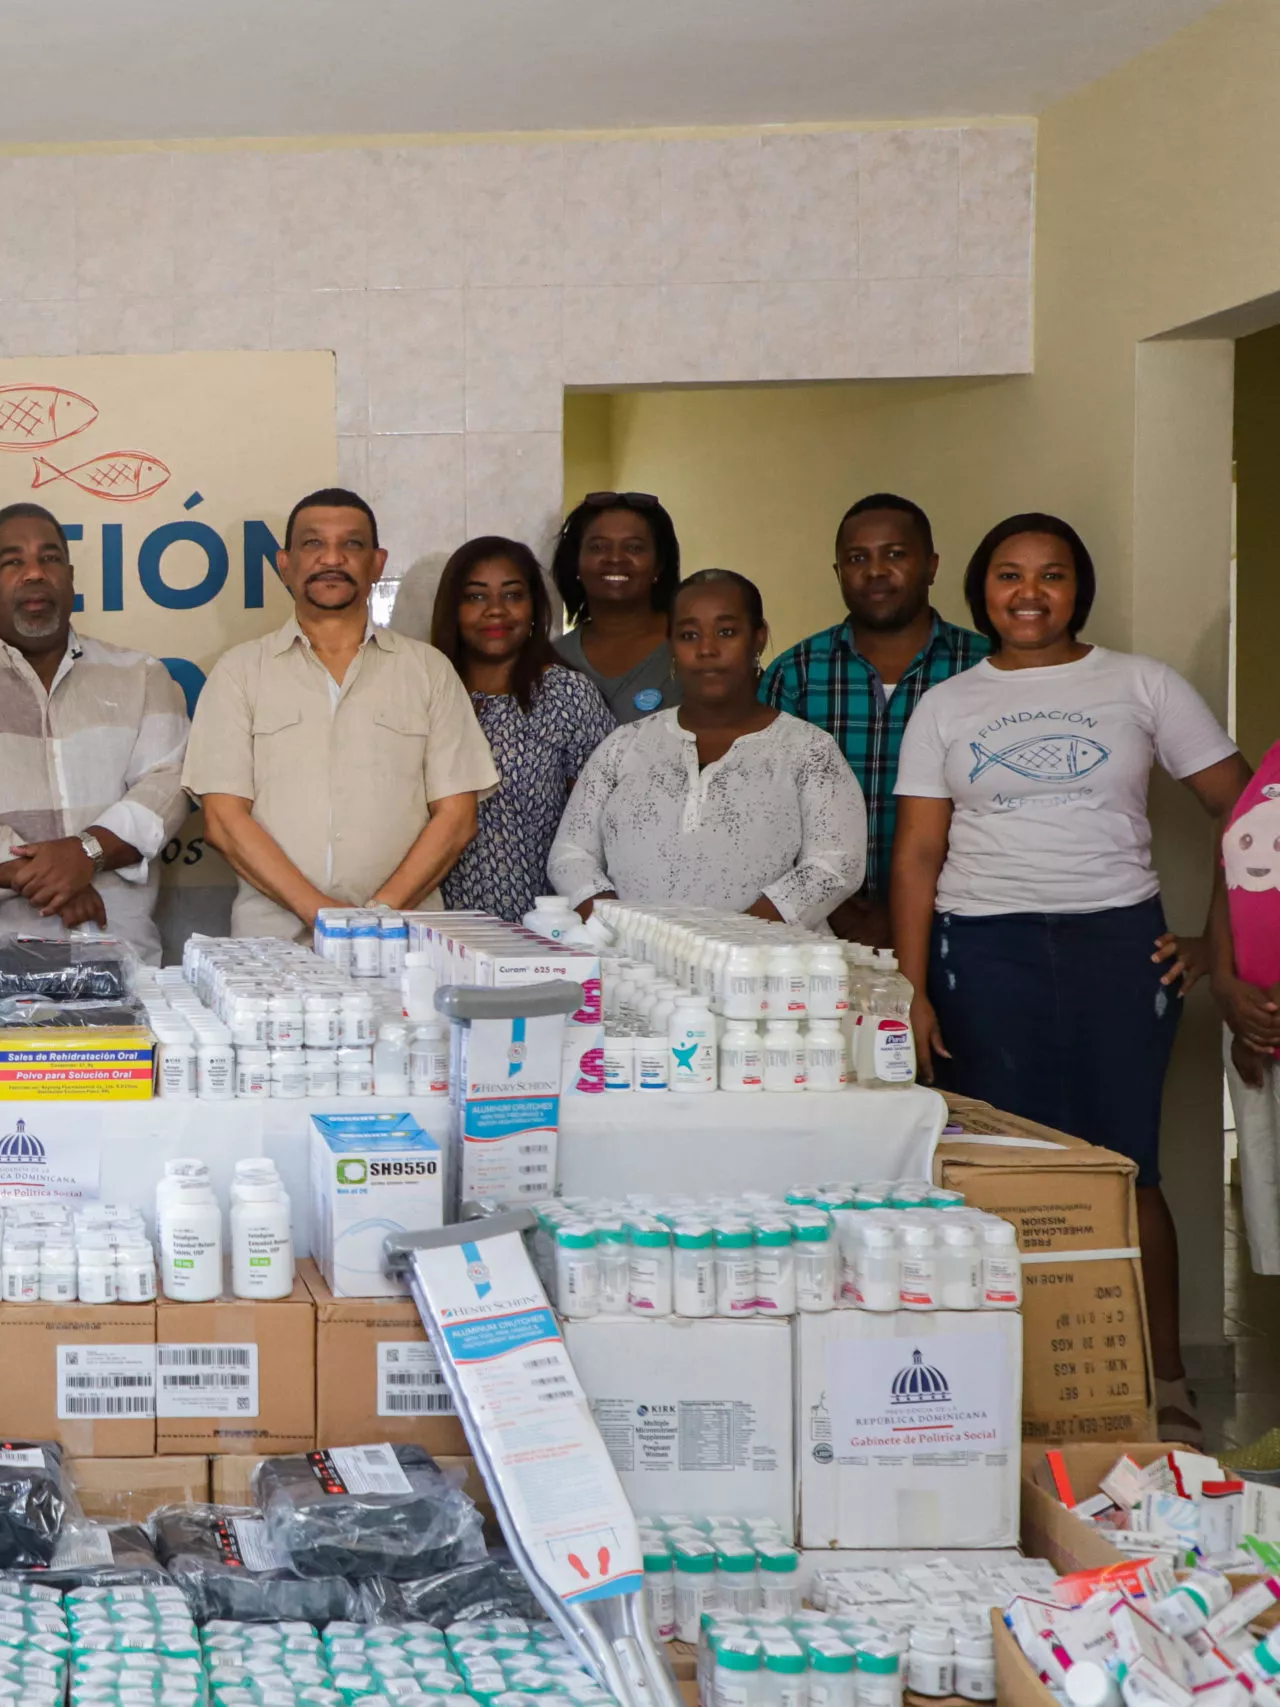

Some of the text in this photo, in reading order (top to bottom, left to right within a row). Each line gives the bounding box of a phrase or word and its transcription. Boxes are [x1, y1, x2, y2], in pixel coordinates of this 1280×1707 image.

[534, 966, 550, 974] 625
[553, 966, 567, 975] mg
[8, 1051, 139, 1062] Sales de Rehidratación Oral
[16, 1070, 133, 1081] Polvo para Solución Oral
[369, 1161, 437, 1176] SH9550
[15, 1173, 77, 1184] DOMINICANA
[1, 1188, 12, 1197] de
[53, 1188, 83, 1198] Social
[1021, 1216, 1067, 1226] MISSION
[1022, 1225, 1094, 1237] WHEELCHAIR
[1023, 1238, 1052, 1248] FREE
[1025, 1273, 1074, 1285] MADE IN
[1051, 1337, 1074, 1352] KGS
[1053, 1362, 1077, 1377] KGS
[1058, 1386, 1079, 1400] SET
[1088, 1386, 1095, 1397] 1
[651, 1405, 676, 1413] KIRK
[917, 1410, 988, 1424] DOMINICANA
[638, 1434, 676, 1442] Supplement
[850, 1434, 901, 1448] Gabinete
[903, 1433, 917, 1445] de
[963, 1428, 997, 1440] Social
[642, 1444, 671, 1452] Pregnant
